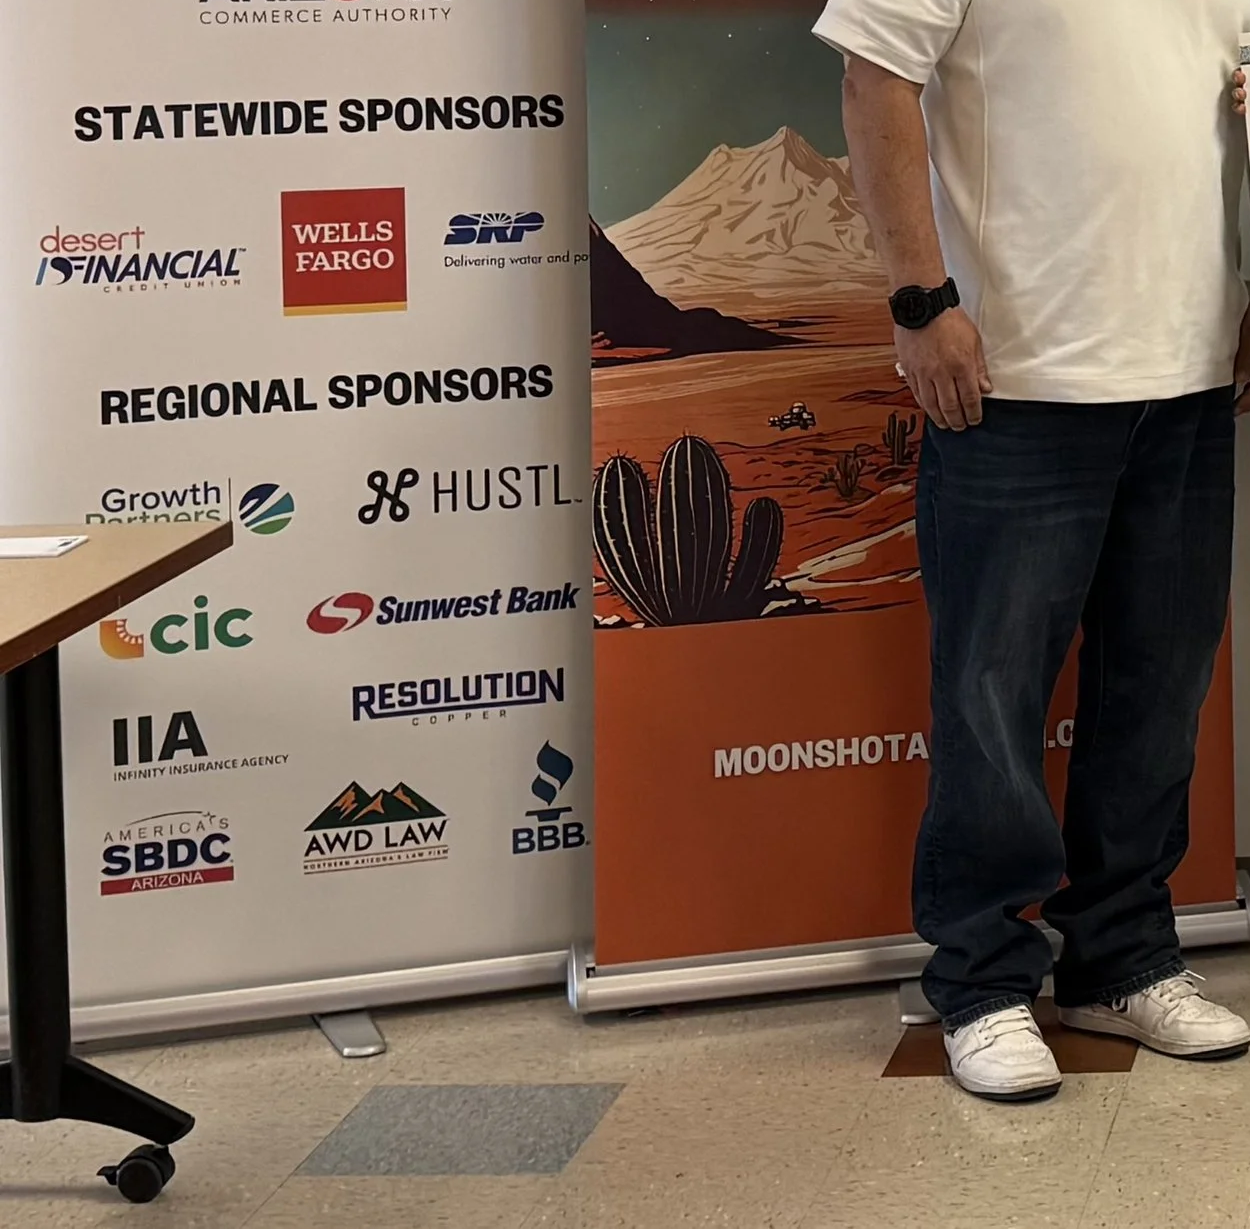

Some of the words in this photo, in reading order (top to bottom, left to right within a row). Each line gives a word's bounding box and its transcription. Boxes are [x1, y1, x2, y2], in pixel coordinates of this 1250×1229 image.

[200, 9, 322, 25] COMMERCE
[332, 7, 451, 22] AUTHORITY
[74, 100, 327, 141] STATEWIDE
[339, 94, 565, 133] SPONSORS
[40, 225, 145, 254] desert
[291, 221, 393, 245] WELLS
[443, 211, 545, 245] SRP
[296, 249, 395, 272] FARGO
[444, 254, 505, 269] Delivering
[510, 256, 542, 265] water
[547, 251, 570, 264] and
[104, 283, 168, 293] CREDIT
[185, 279, 241, 289] UNION
[101, 378, 317, 425] REGIONAL
[327, 364, 554, 410] SPONSORS
[101, 481, 221, 513] Growth
[433, 464, 572, 513] HUSTL
[376, 589, 502, 625] Sunwest
[506, 582, 581, 615] Bank
[150, 595, 253, 654] cic
[352, 668, 564, 721] RESOLUTION
[412, 709, 507, 726] COPPER
[113, 711, 208, 766] IIA
[114, 766, 165, 782] INFINITY
[169, 759, 237, 775] INSURANCE
[241, 754, 289, 767] AGENCY
[304, 830, 373, 857] AWD
[385, 820, 447, 848] LAW
[513, 822, 585, 854] BBB
[101, 833, 231, 876] SBDC
[131, 872, 204, 891] ARIZONA
